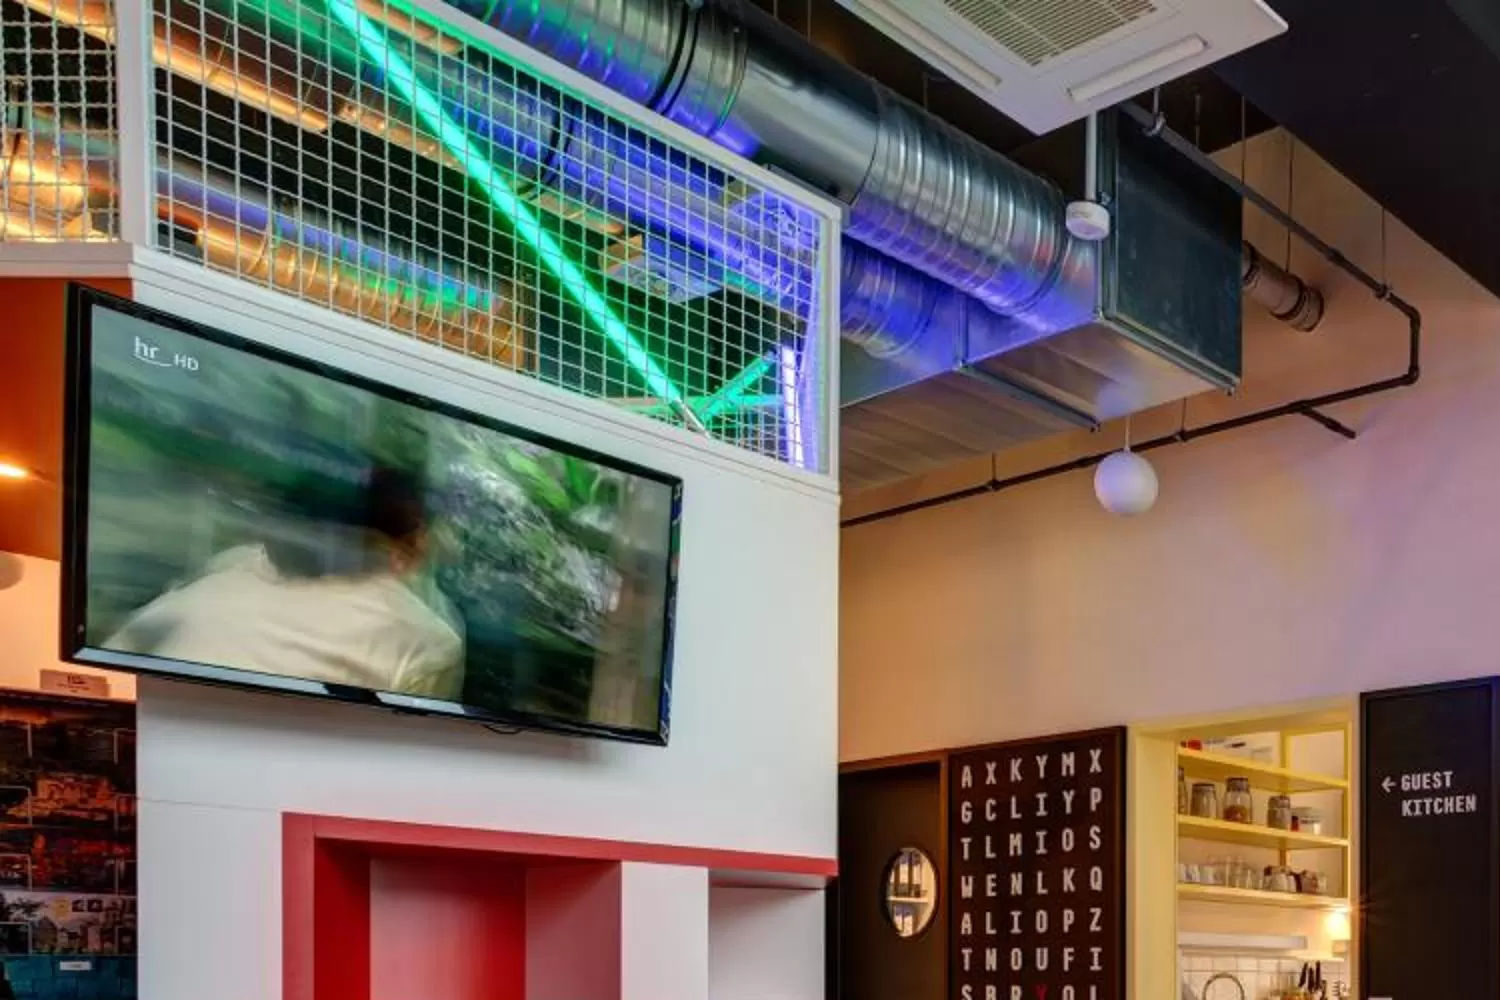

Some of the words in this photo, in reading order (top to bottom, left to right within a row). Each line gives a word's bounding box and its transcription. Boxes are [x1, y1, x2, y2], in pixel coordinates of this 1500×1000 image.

[135, 336, 159, 358] hr
[174, 353, 199, 370] HD
[1401, 771, 1453, 791] GUEST
[1401, 794, 1476, 816] KITCHEN
